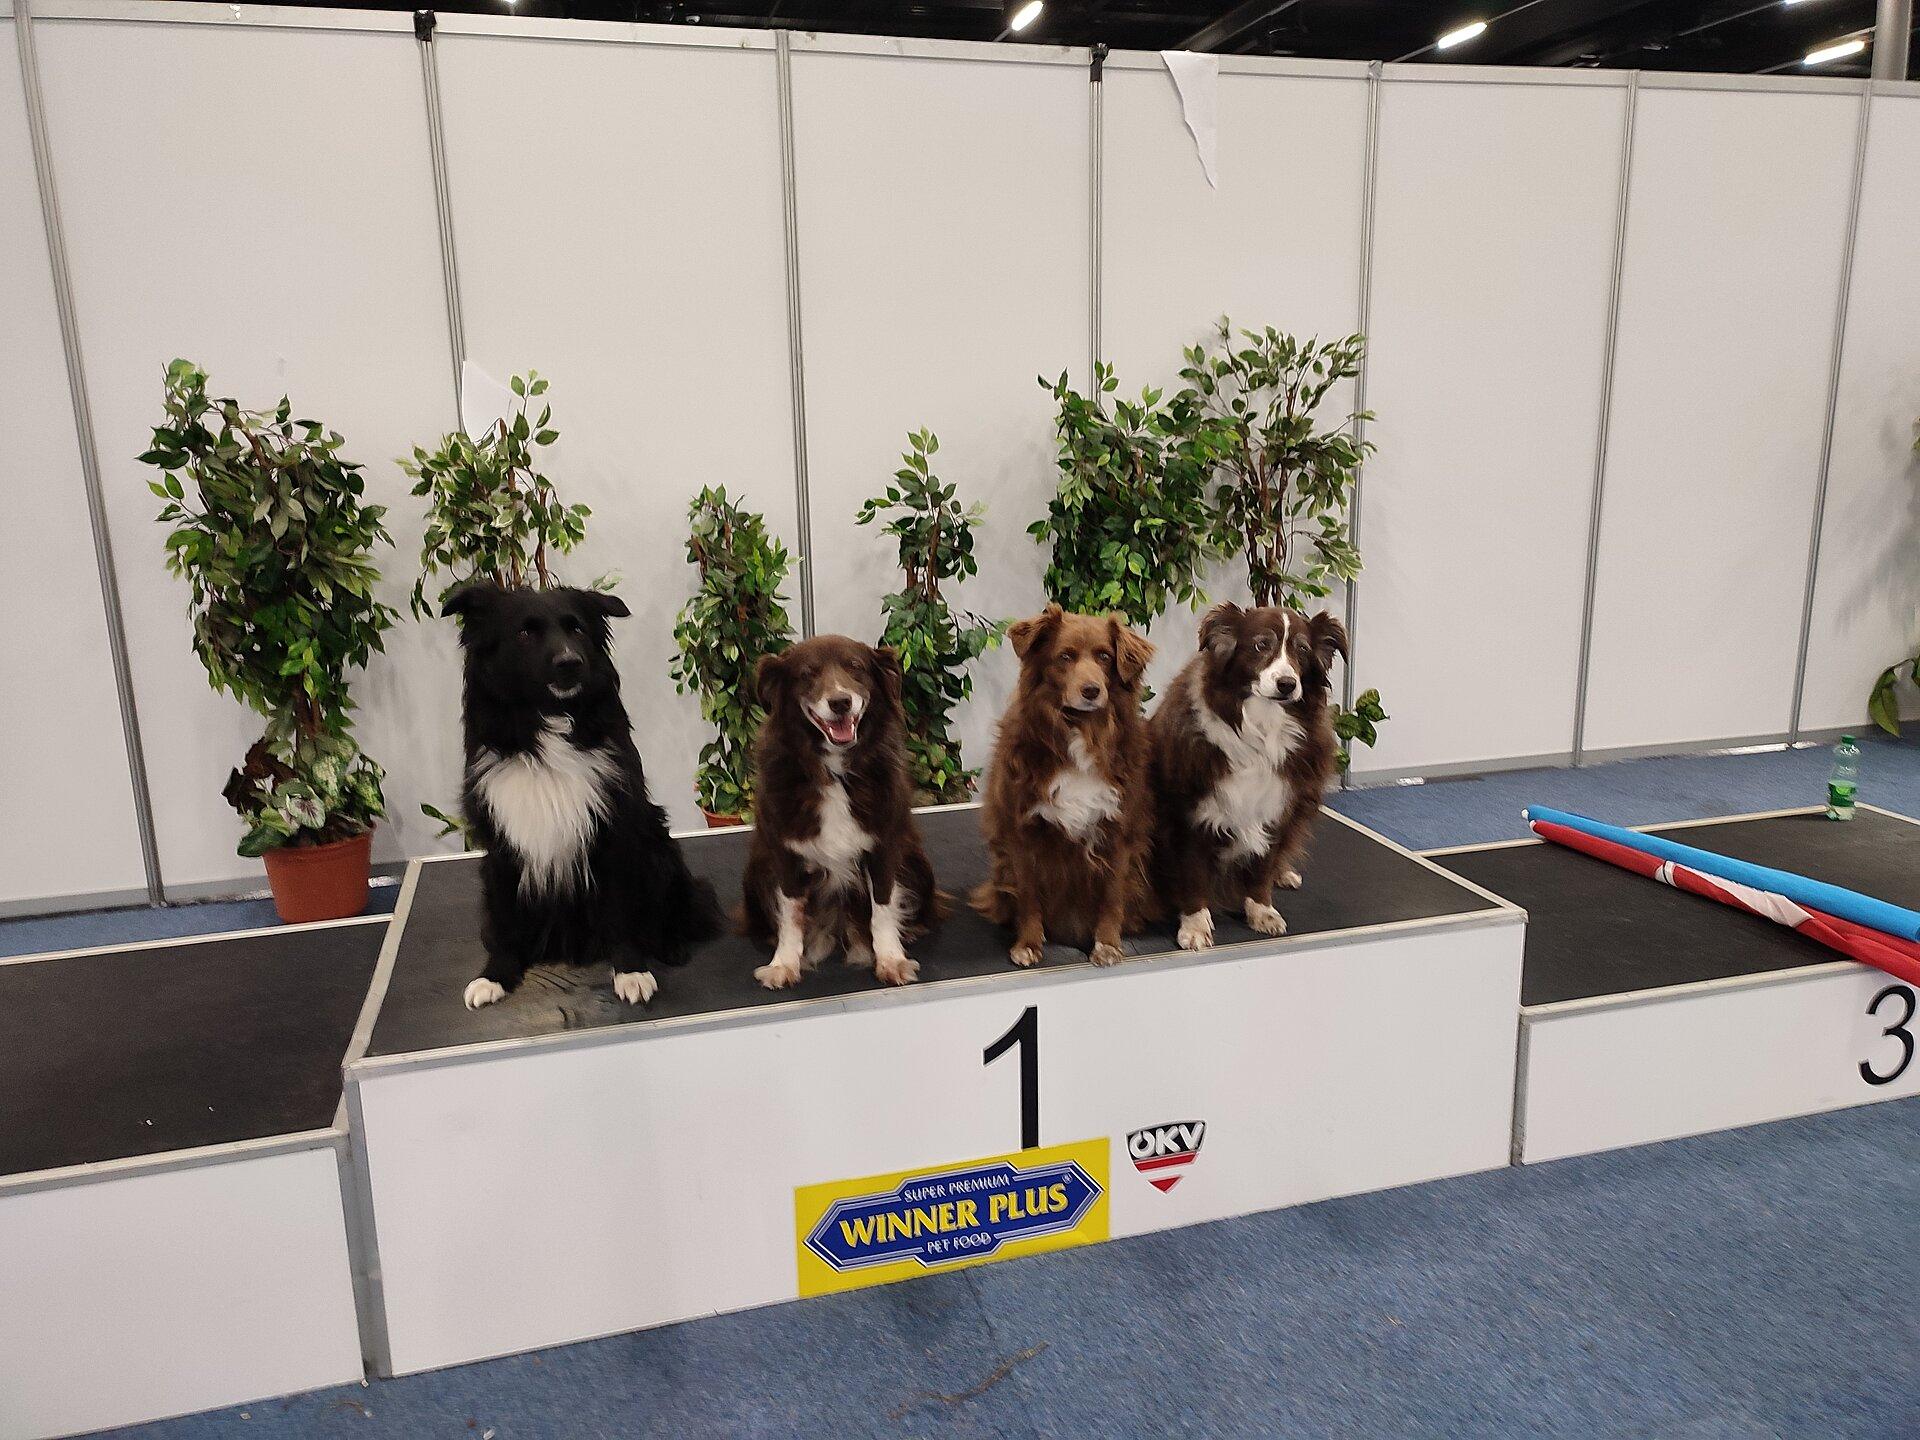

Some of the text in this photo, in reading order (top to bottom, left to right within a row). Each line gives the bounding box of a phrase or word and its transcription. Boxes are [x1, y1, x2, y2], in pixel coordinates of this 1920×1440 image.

[1858, 984, 1916, 1085] 3
[983, 1004, 1039, 1149] 1
[838, 1182, 1069, 1249] WINNER PLUS
[903, 1173, 1011, 1203] SUPER PREMIUM
[926, 1231, 992, 1255] PET FOOD
